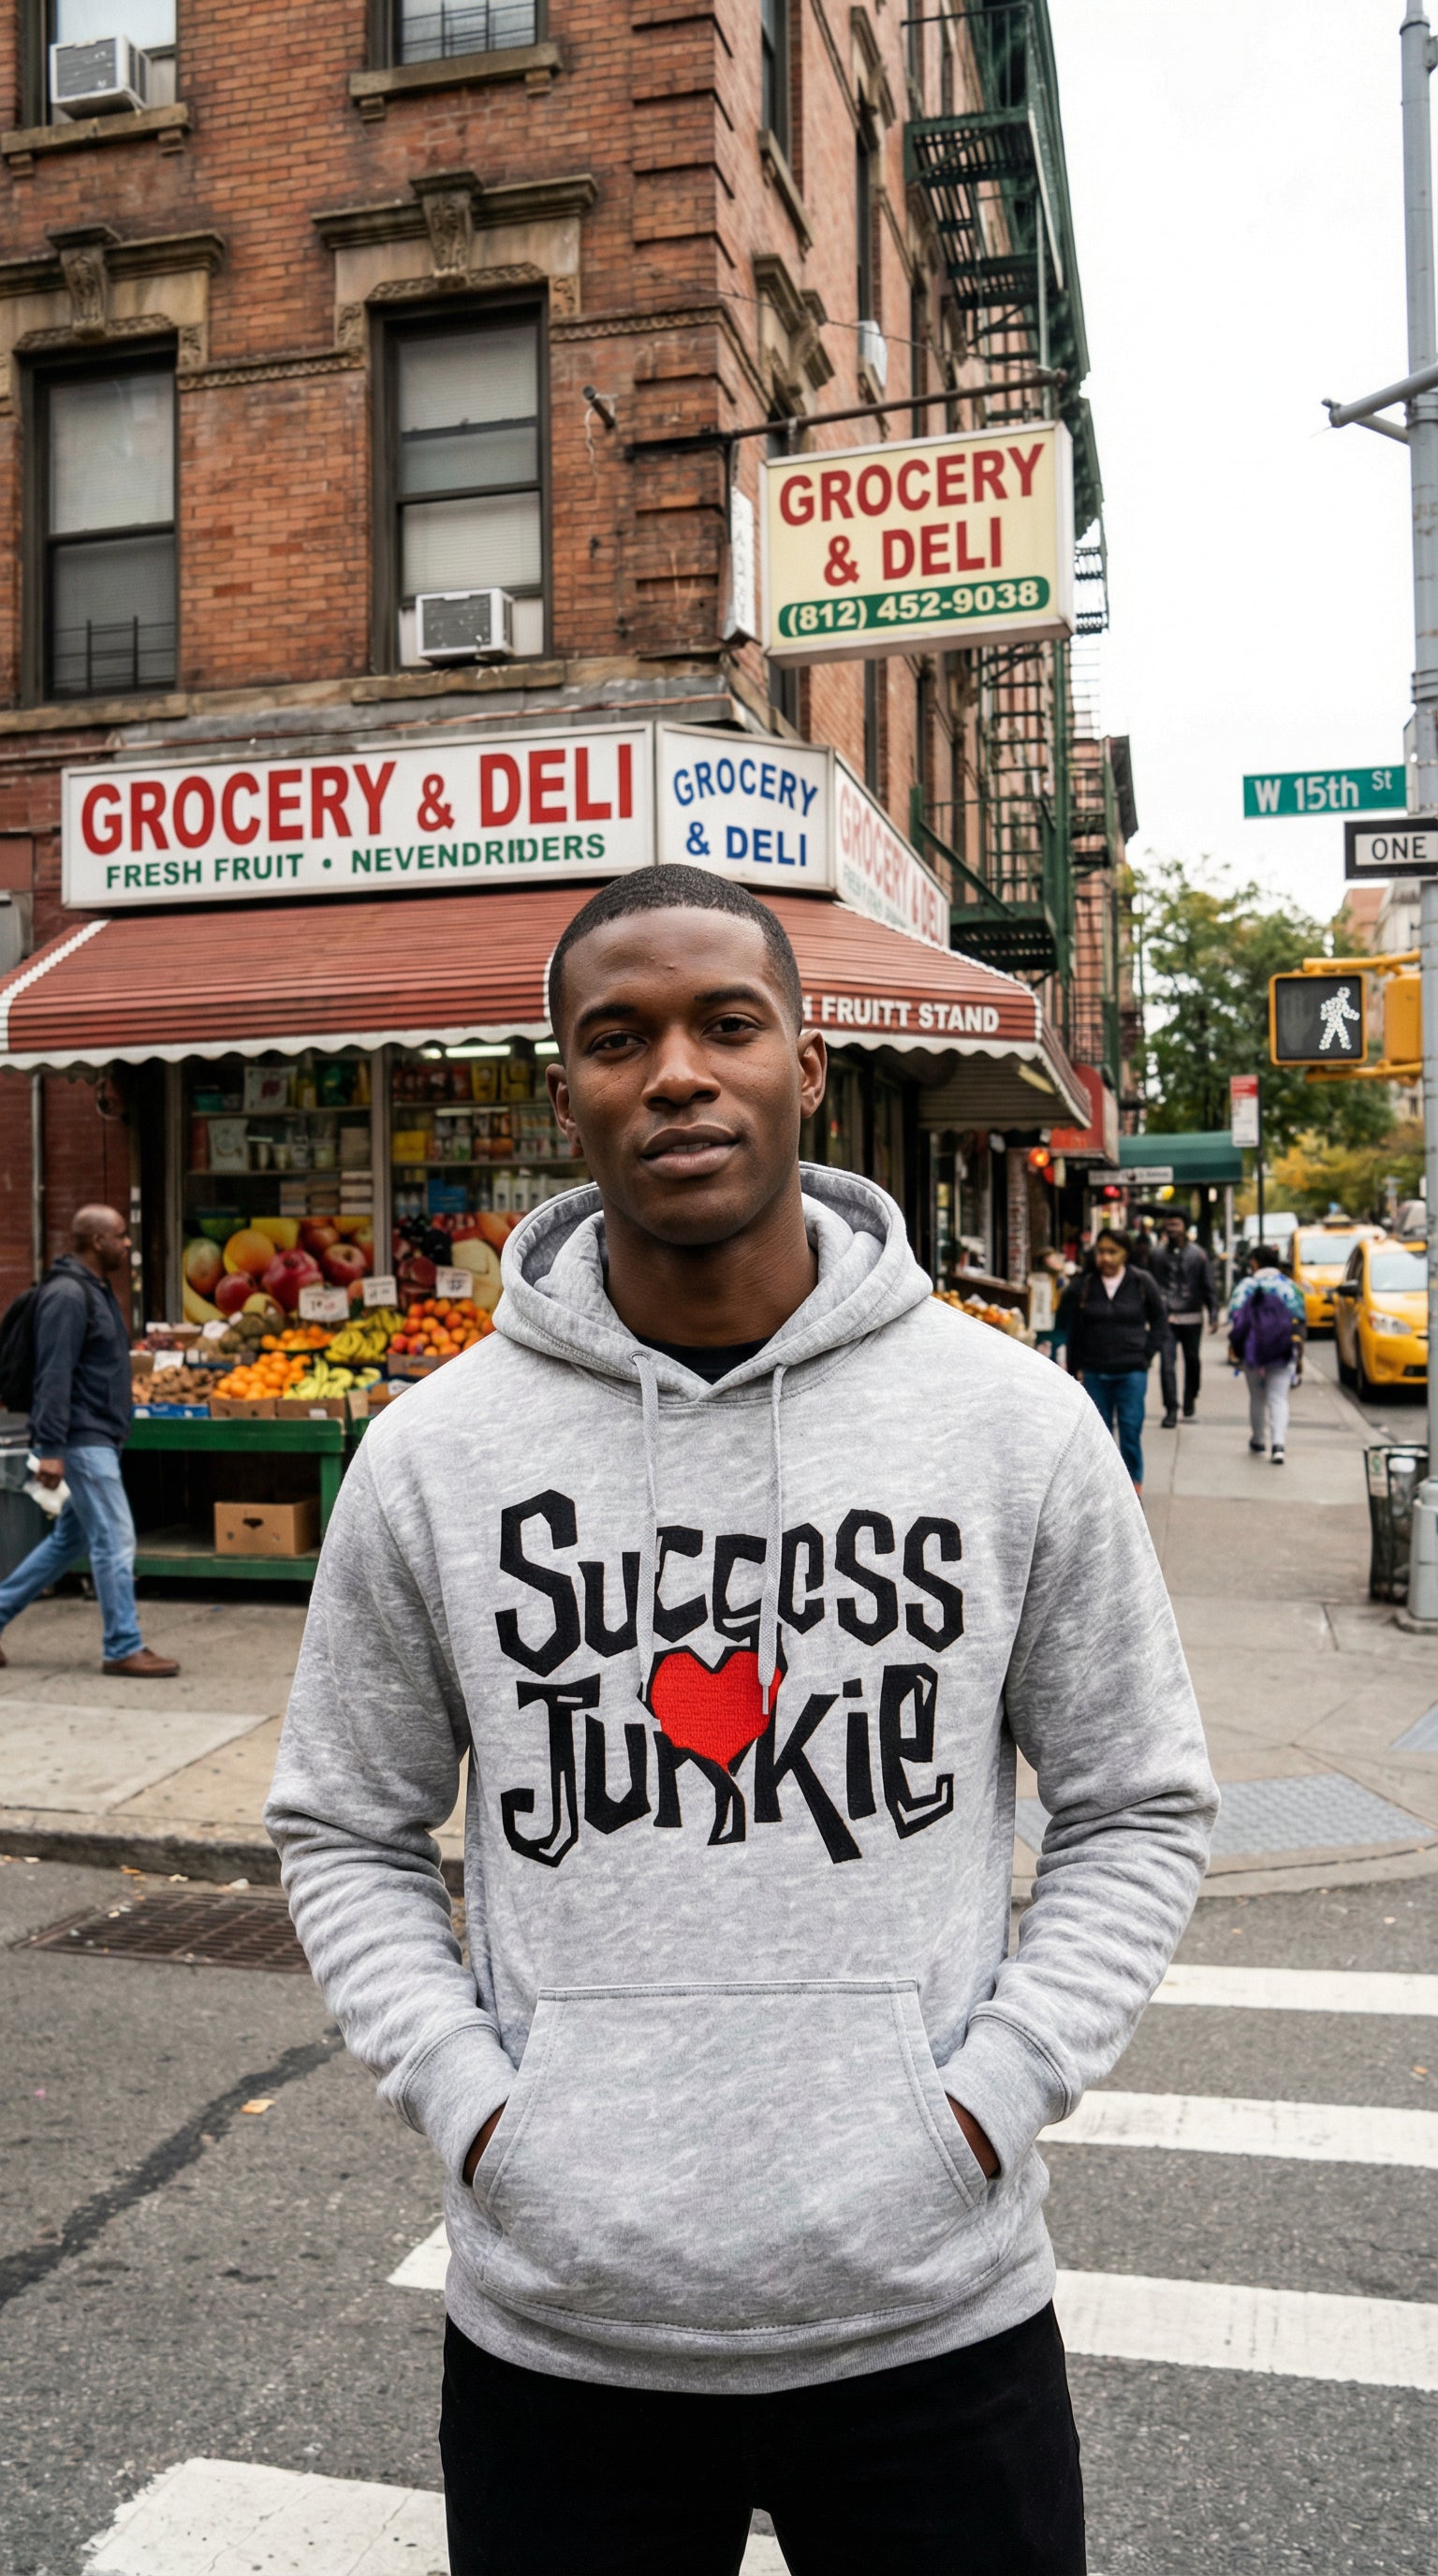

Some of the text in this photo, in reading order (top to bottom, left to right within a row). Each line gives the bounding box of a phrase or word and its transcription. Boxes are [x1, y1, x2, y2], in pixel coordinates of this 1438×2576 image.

[780, 444, 1044, 526] GROCERY
[824, 534, 859, 587] &
[882, 517, 1002, 580] DELI
[786, 580, 1040, 637] (812) 452-9038
[81, 744, 633, 856] GROCERY & DELI
[672, 757, 818, 817] GROCERY
[1254, 769, 1393, 813] W 15th St
[685, 821, 807, 867] & DELI
[1372, 836, 1428, 861] ONE
[106, 860, 202, 889] FRESH
[213, 853, 303, 882] FRUIT
[821, 995, 912, 1028] FRUITT
[918, 1003, 1000, 1032] STAND
